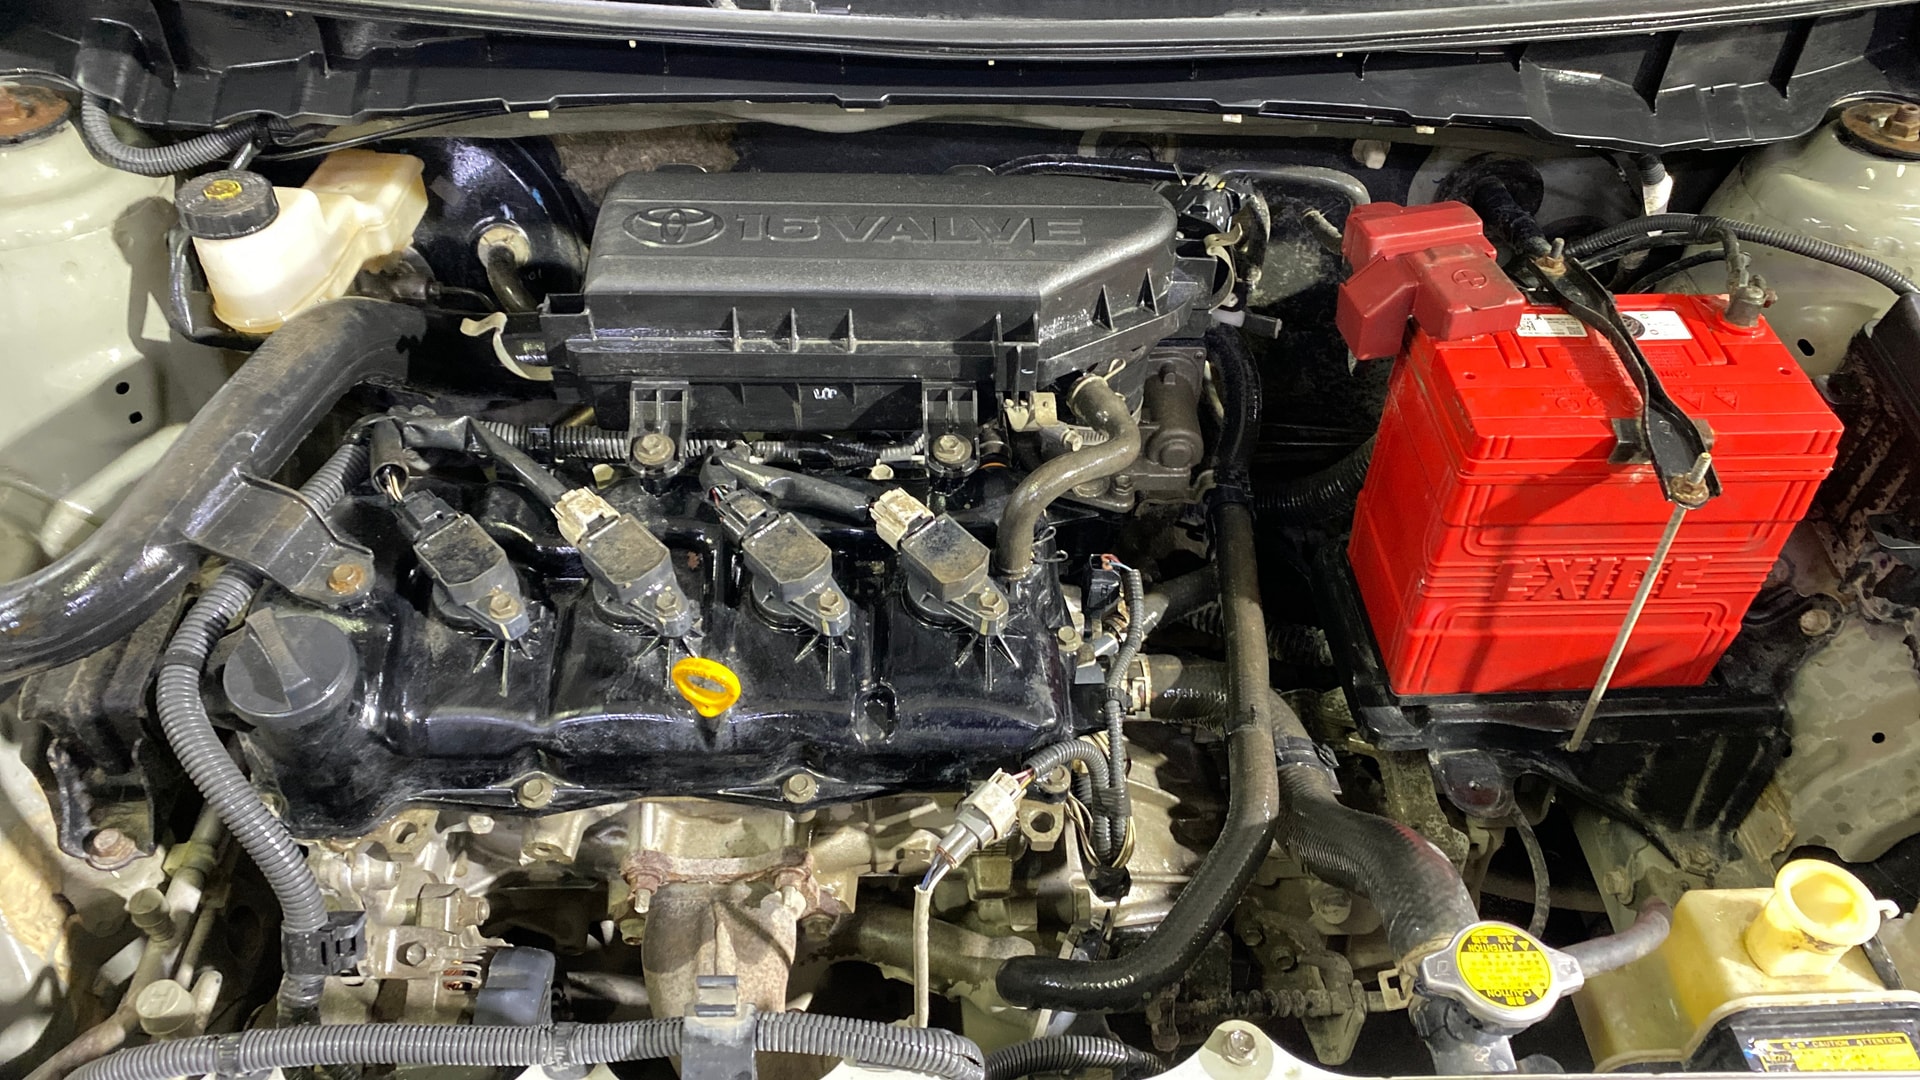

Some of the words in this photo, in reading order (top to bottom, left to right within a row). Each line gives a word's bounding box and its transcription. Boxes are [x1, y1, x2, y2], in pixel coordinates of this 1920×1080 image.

[1488, 555, 1713, 601] EXIDE
[1486, 988, 1532, 998] CAUTION
[1812, 1039, 1850, 1048] CAUTION
[1856, 1036, 1904, 1047] ATTENTION
